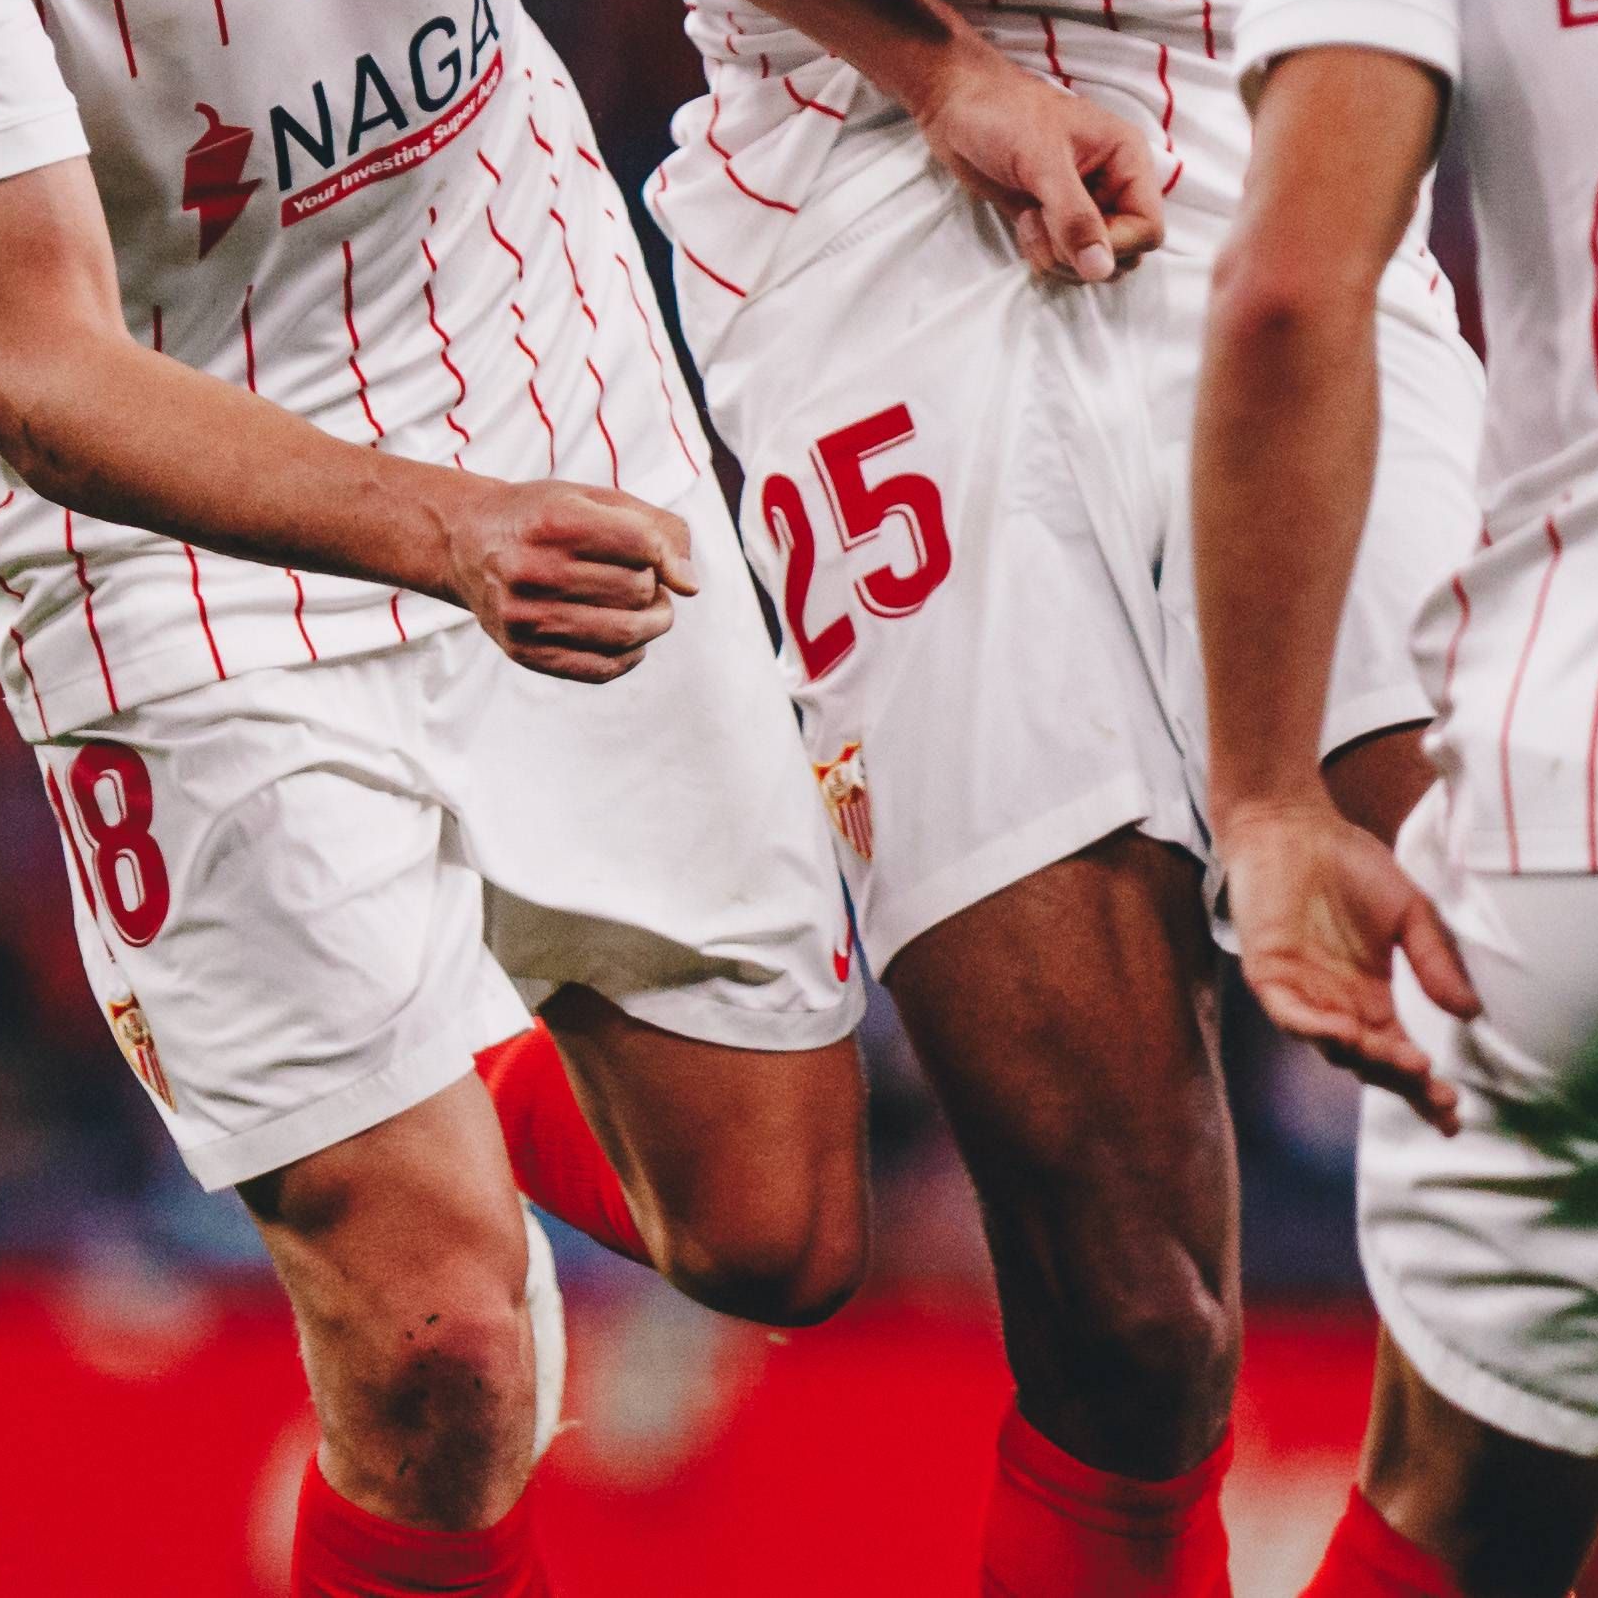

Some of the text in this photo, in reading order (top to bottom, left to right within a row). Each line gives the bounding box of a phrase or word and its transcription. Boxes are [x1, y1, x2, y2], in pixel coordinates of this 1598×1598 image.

[293, 182, 338, 213] Your
[341, 138, 432, 190] Investing
[433, 96, 477, 145] Super
[761, 401, 952, 682] 25
[47, 740, 171, 947] 18
